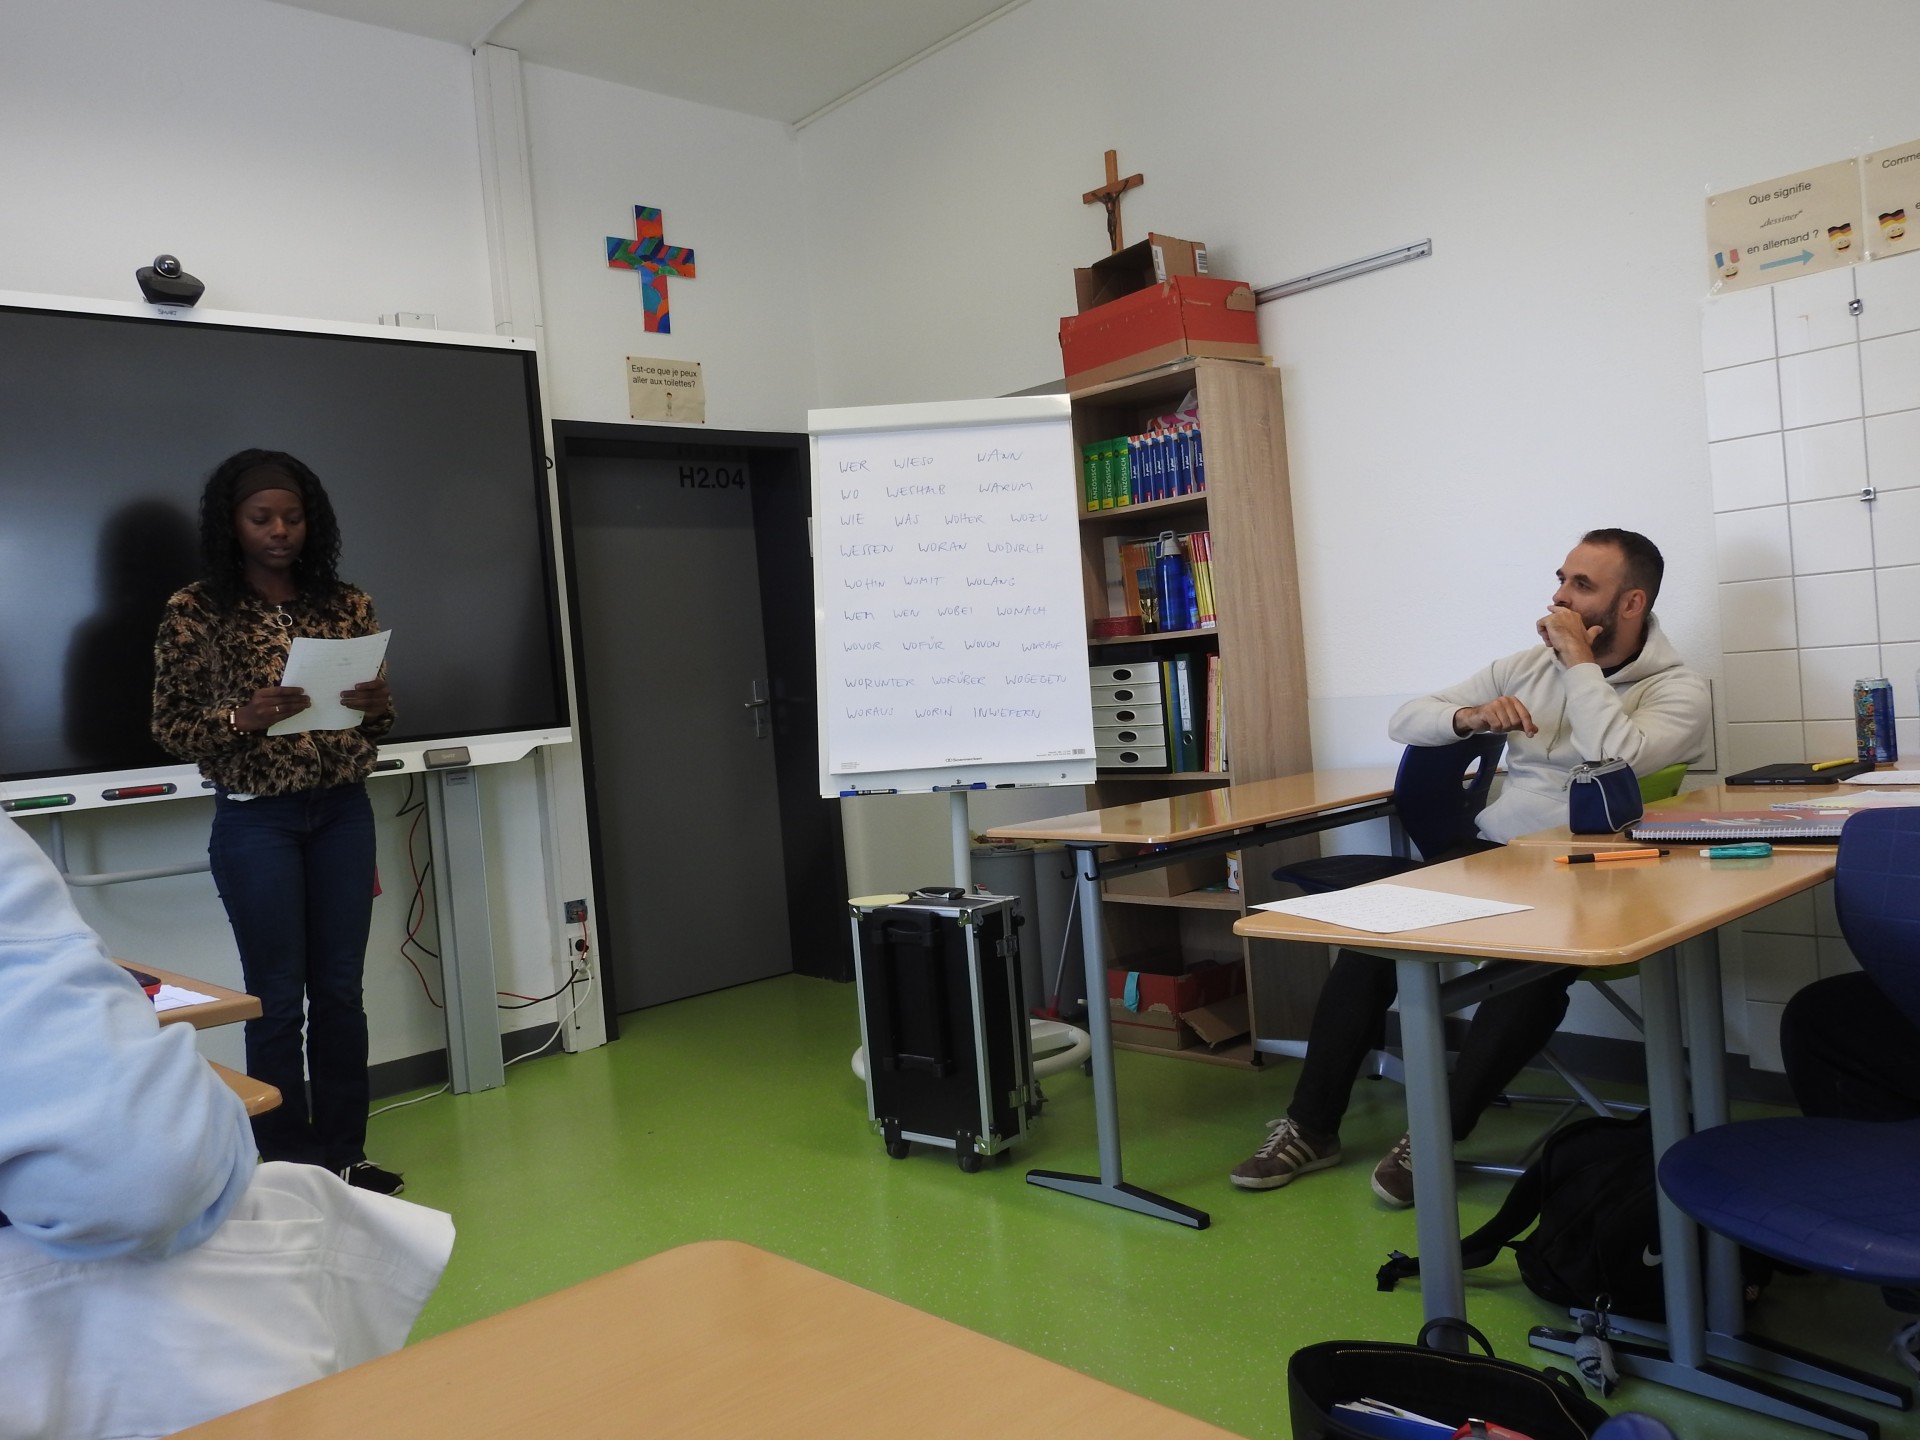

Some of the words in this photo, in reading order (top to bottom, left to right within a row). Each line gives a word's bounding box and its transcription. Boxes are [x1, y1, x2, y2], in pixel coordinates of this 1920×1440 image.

[1748, 194, 1771, 206] Que
[1773, 181, 1812, 199] signifie
[1747, 245, 1760, 255] en
[1762, 231, 1810, 251] allemand
[1812, 229, 1819, 239] ?
[631, 364, 656, 374] Est-ce
[656, 368, 671, 376] que
[671, 369, 679, 378] je
[680, 369, 698, 378] peux
[632, 375, 648, 384] aller
[664, 379, 696, 388] toilettes?
[839, 460, 871, 473] WER
[894, 457, 933, 470] WIESO
[978, 449, 1023, 463] WANN
[679, 466, 746, 489] H2.04
[841, 489, 859, 500] WO
[979, 481, 1033, 493] WARUM
[841, 513, 864, 525] WIE
[895, 513, 920, 527] WAS
[945, 513, 984, 525] WOHER
[840, 544, 893, 557] WESSEN
[918, 542, 968, 552] WORAN
[987, 542, 1044, 553] WODURCH
[844, 578, 885, 590] WOHIN
[904, 576, 943, 586] WOMIT
[844, 610, 875, 622] WEM
[893, 609, 919, 618] WEN
[938, 606, 972, 616] WOBEI
[997, 605, 1047, 616] WONACH
[844, 640, 882, 652] WOVOR
[902, 636, 944, 651] WOFÜR
[964, 640, 1000, 650] WOVON
[845, 678, 915, 690] WORUNTER
[932, 672, 985, 685] WORÜBER
[846, 707, 893, 719] WORAUS
[914, 706, 952, 719] WORIN
